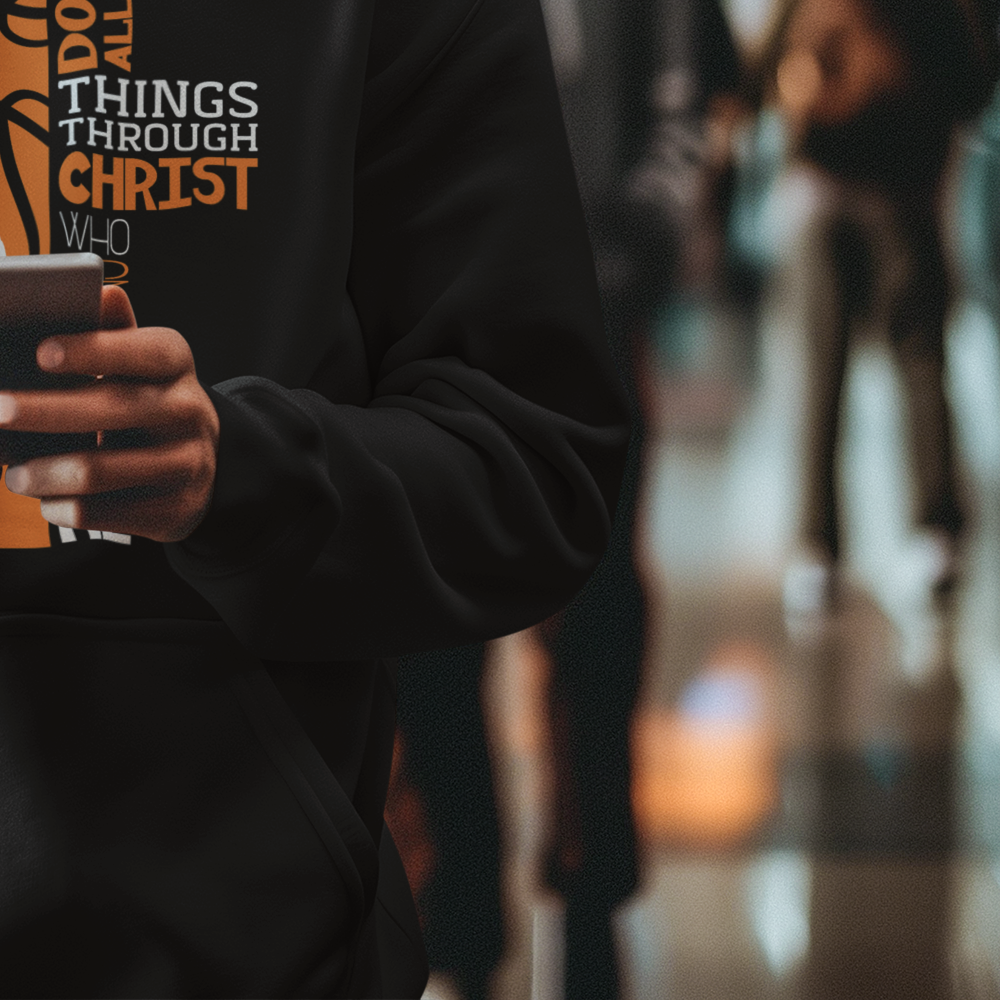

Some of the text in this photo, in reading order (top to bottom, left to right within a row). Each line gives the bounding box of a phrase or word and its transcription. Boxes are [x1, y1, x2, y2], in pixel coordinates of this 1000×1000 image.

[58, 75, 258, 118] THINGS
[58, 117, 258, 152] THROUGH
[58, 151, 258, 210] CHRIST
[59, 211, 130, 256] WHO
